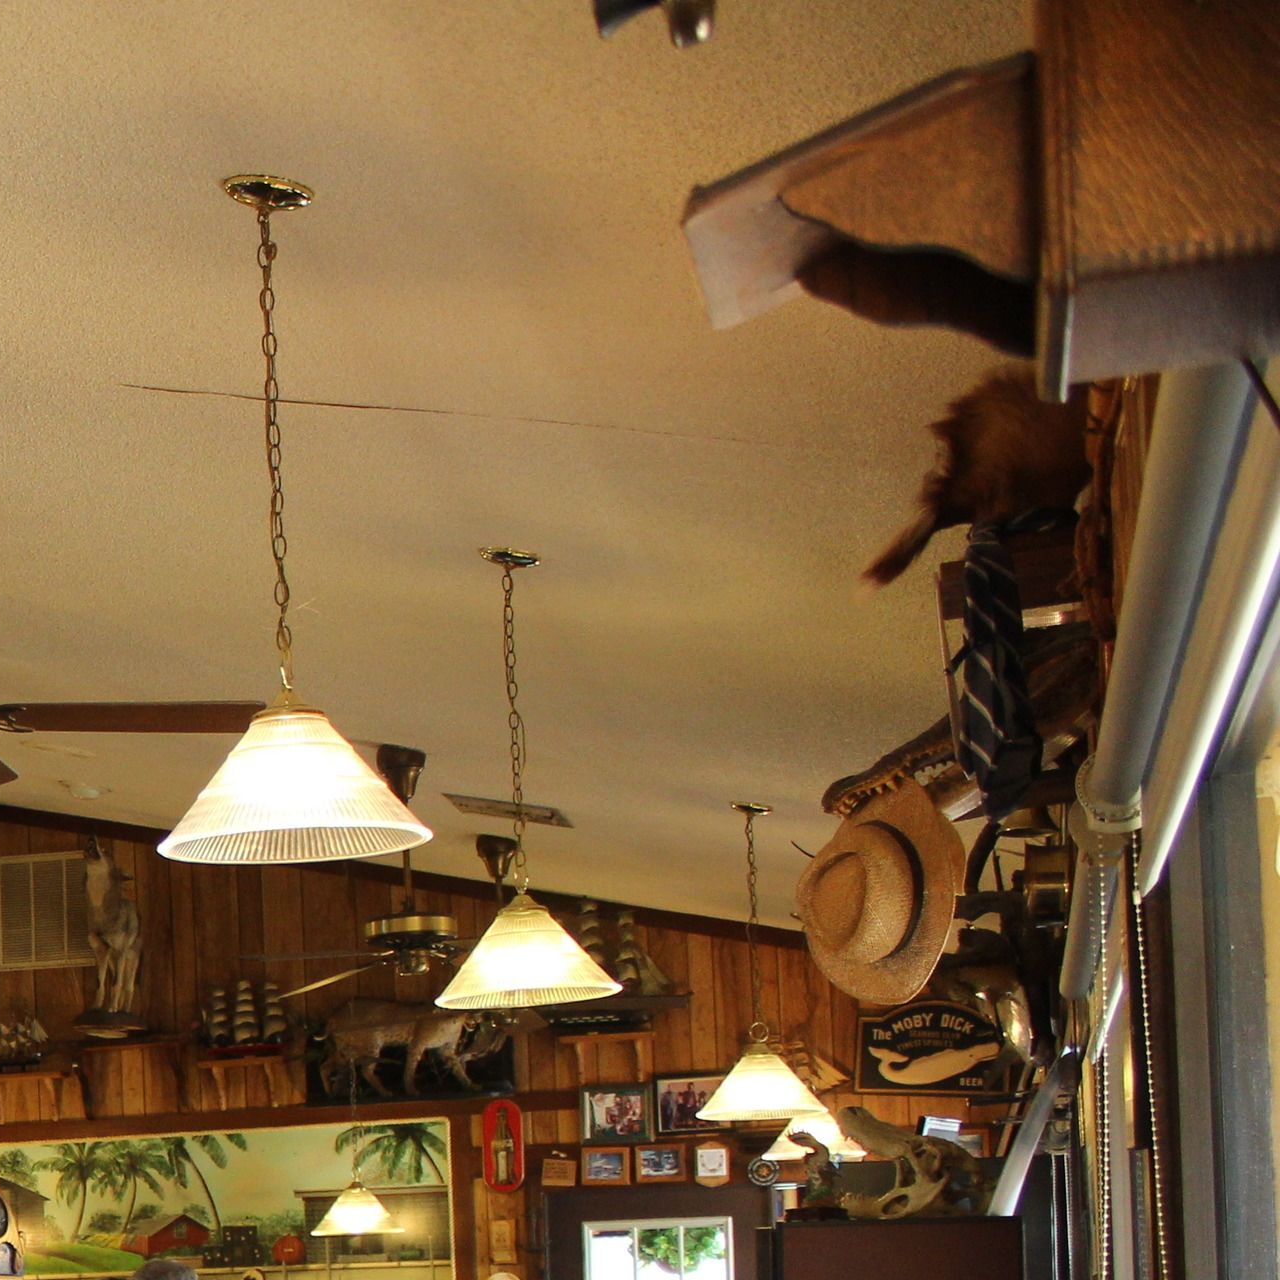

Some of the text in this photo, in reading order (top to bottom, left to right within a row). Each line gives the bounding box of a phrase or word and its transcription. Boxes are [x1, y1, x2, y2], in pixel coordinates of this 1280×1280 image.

[892, 1013, 934, 1034] MOBY
[940, 1013, 975, 1034] DICK
[872, 1028, 893, 1040] The
[960, 1077, 983, 1086] BEER
